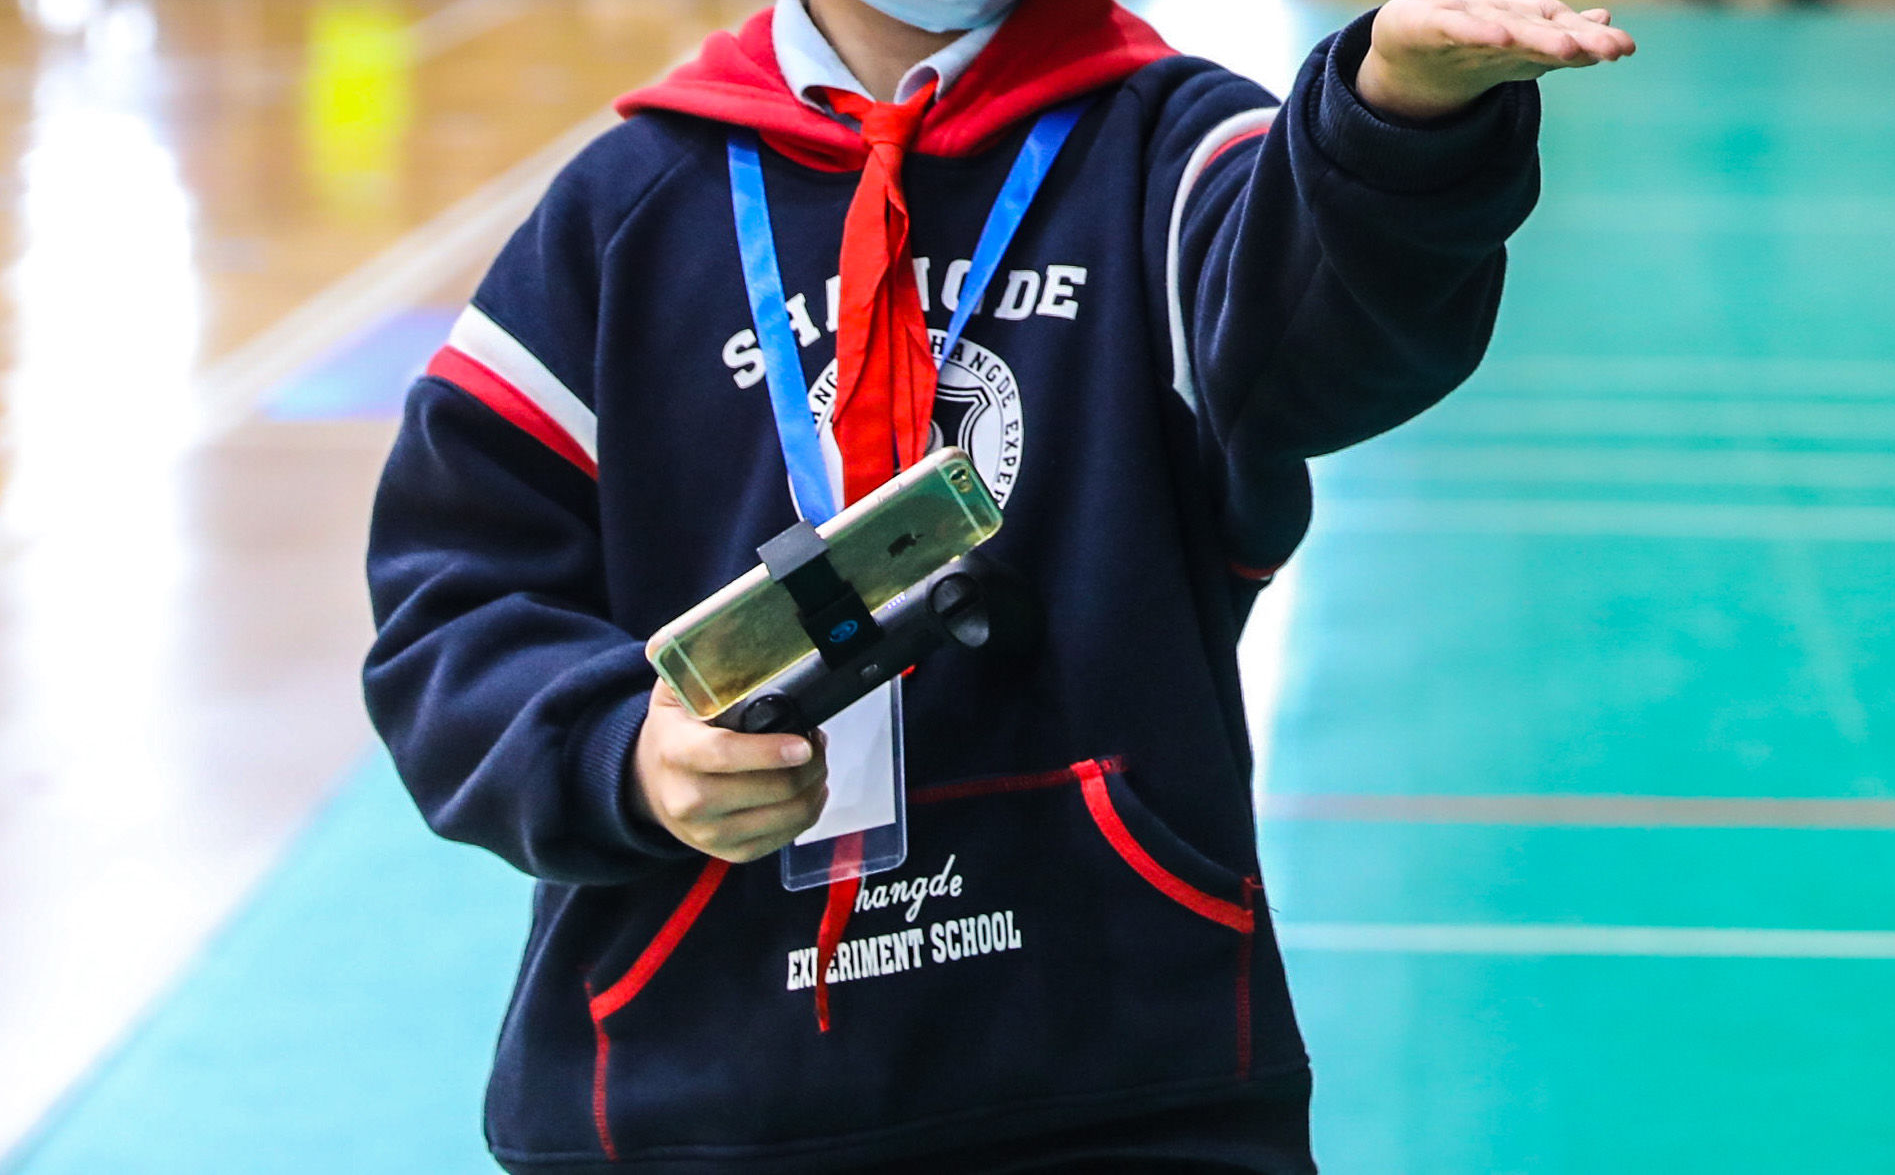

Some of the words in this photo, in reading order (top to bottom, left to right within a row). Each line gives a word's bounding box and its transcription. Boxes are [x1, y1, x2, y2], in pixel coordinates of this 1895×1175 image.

[930, 334, 1018, 409] HANGDE
[854, 854, 963, 923] hangde
[930, 910, 1022, 964] SCHOOL
